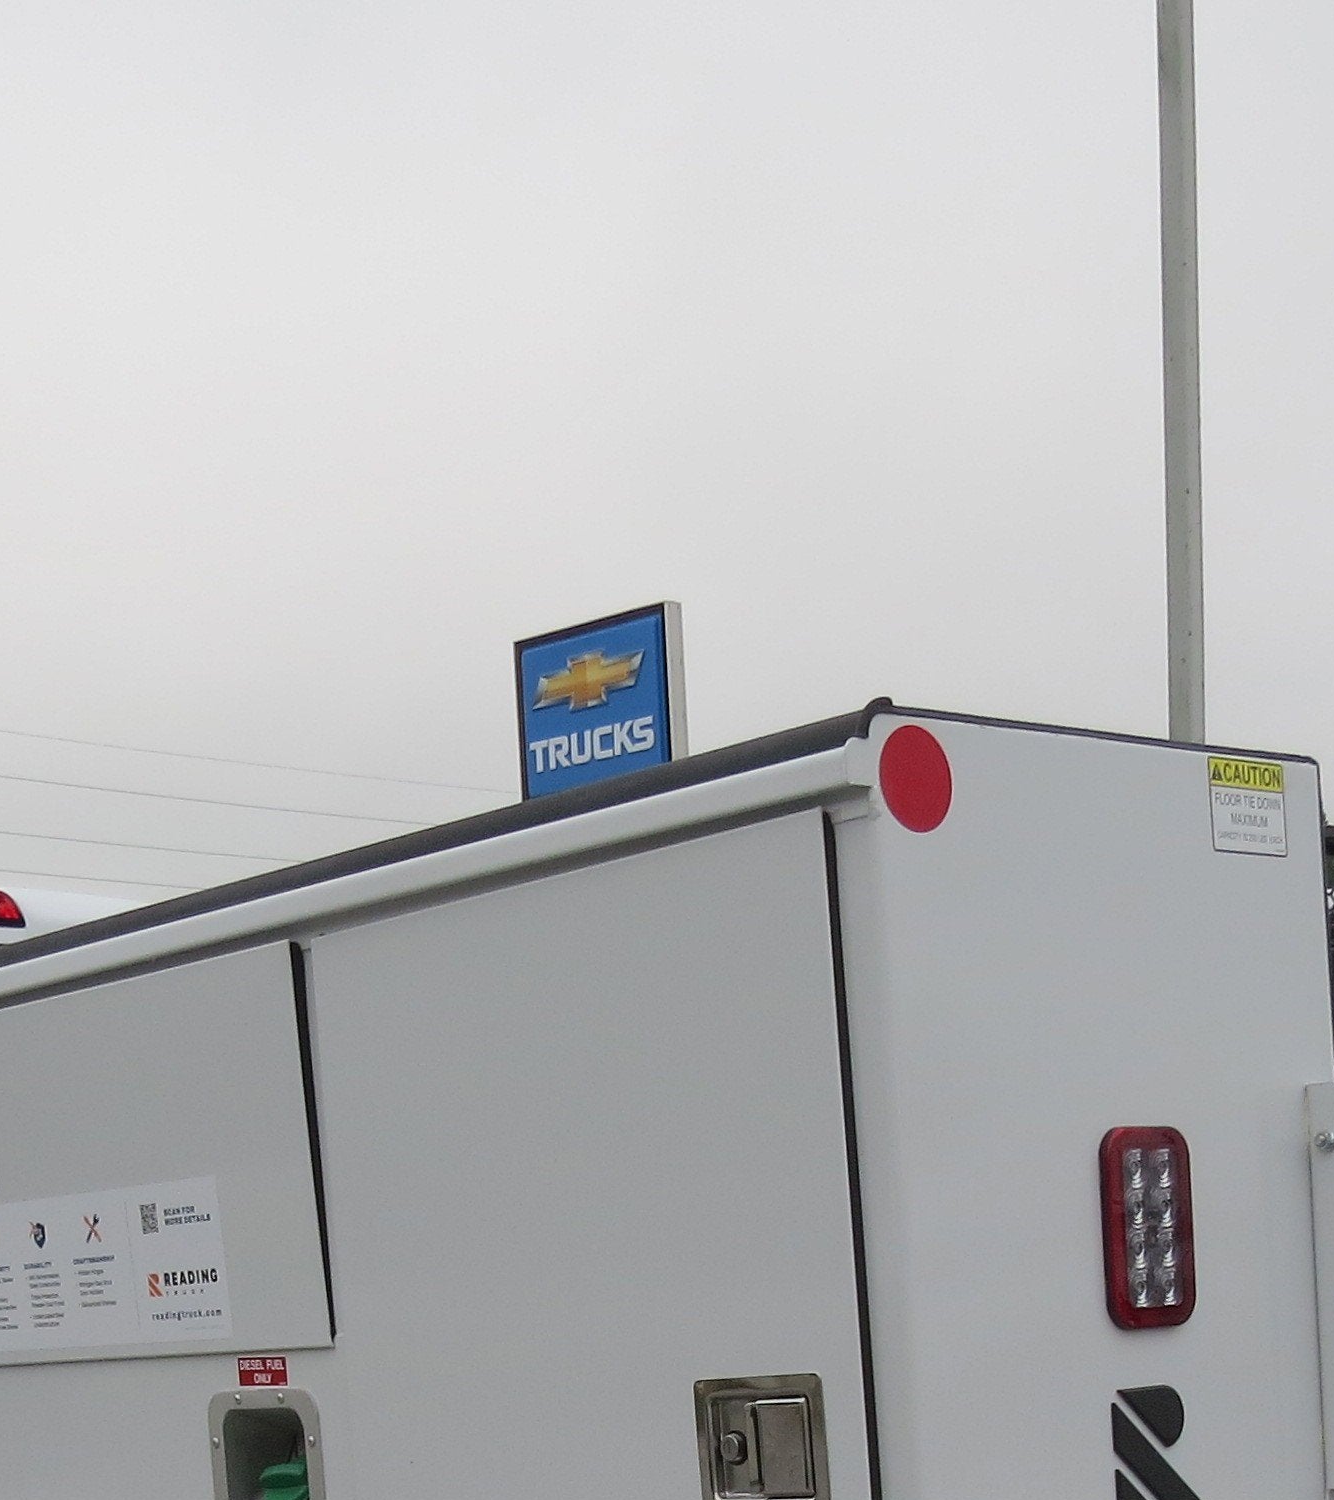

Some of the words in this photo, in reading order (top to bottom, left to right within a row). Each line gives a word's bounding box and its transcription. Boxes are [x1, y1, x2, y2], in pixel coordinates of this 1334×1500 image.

[528, 714, 655, 774] TRUCKS
[1223, 762, 1281, 788] CAUTION
[181, 1205, 196, 1215] FOR
[163, 1267, 219, 1287] READING
[151, 1308, 223, 1322] readingtruck.com
[239, 1358, 265, 1371] DIESEL
[266, 1358, 285, 1370] FUEL
